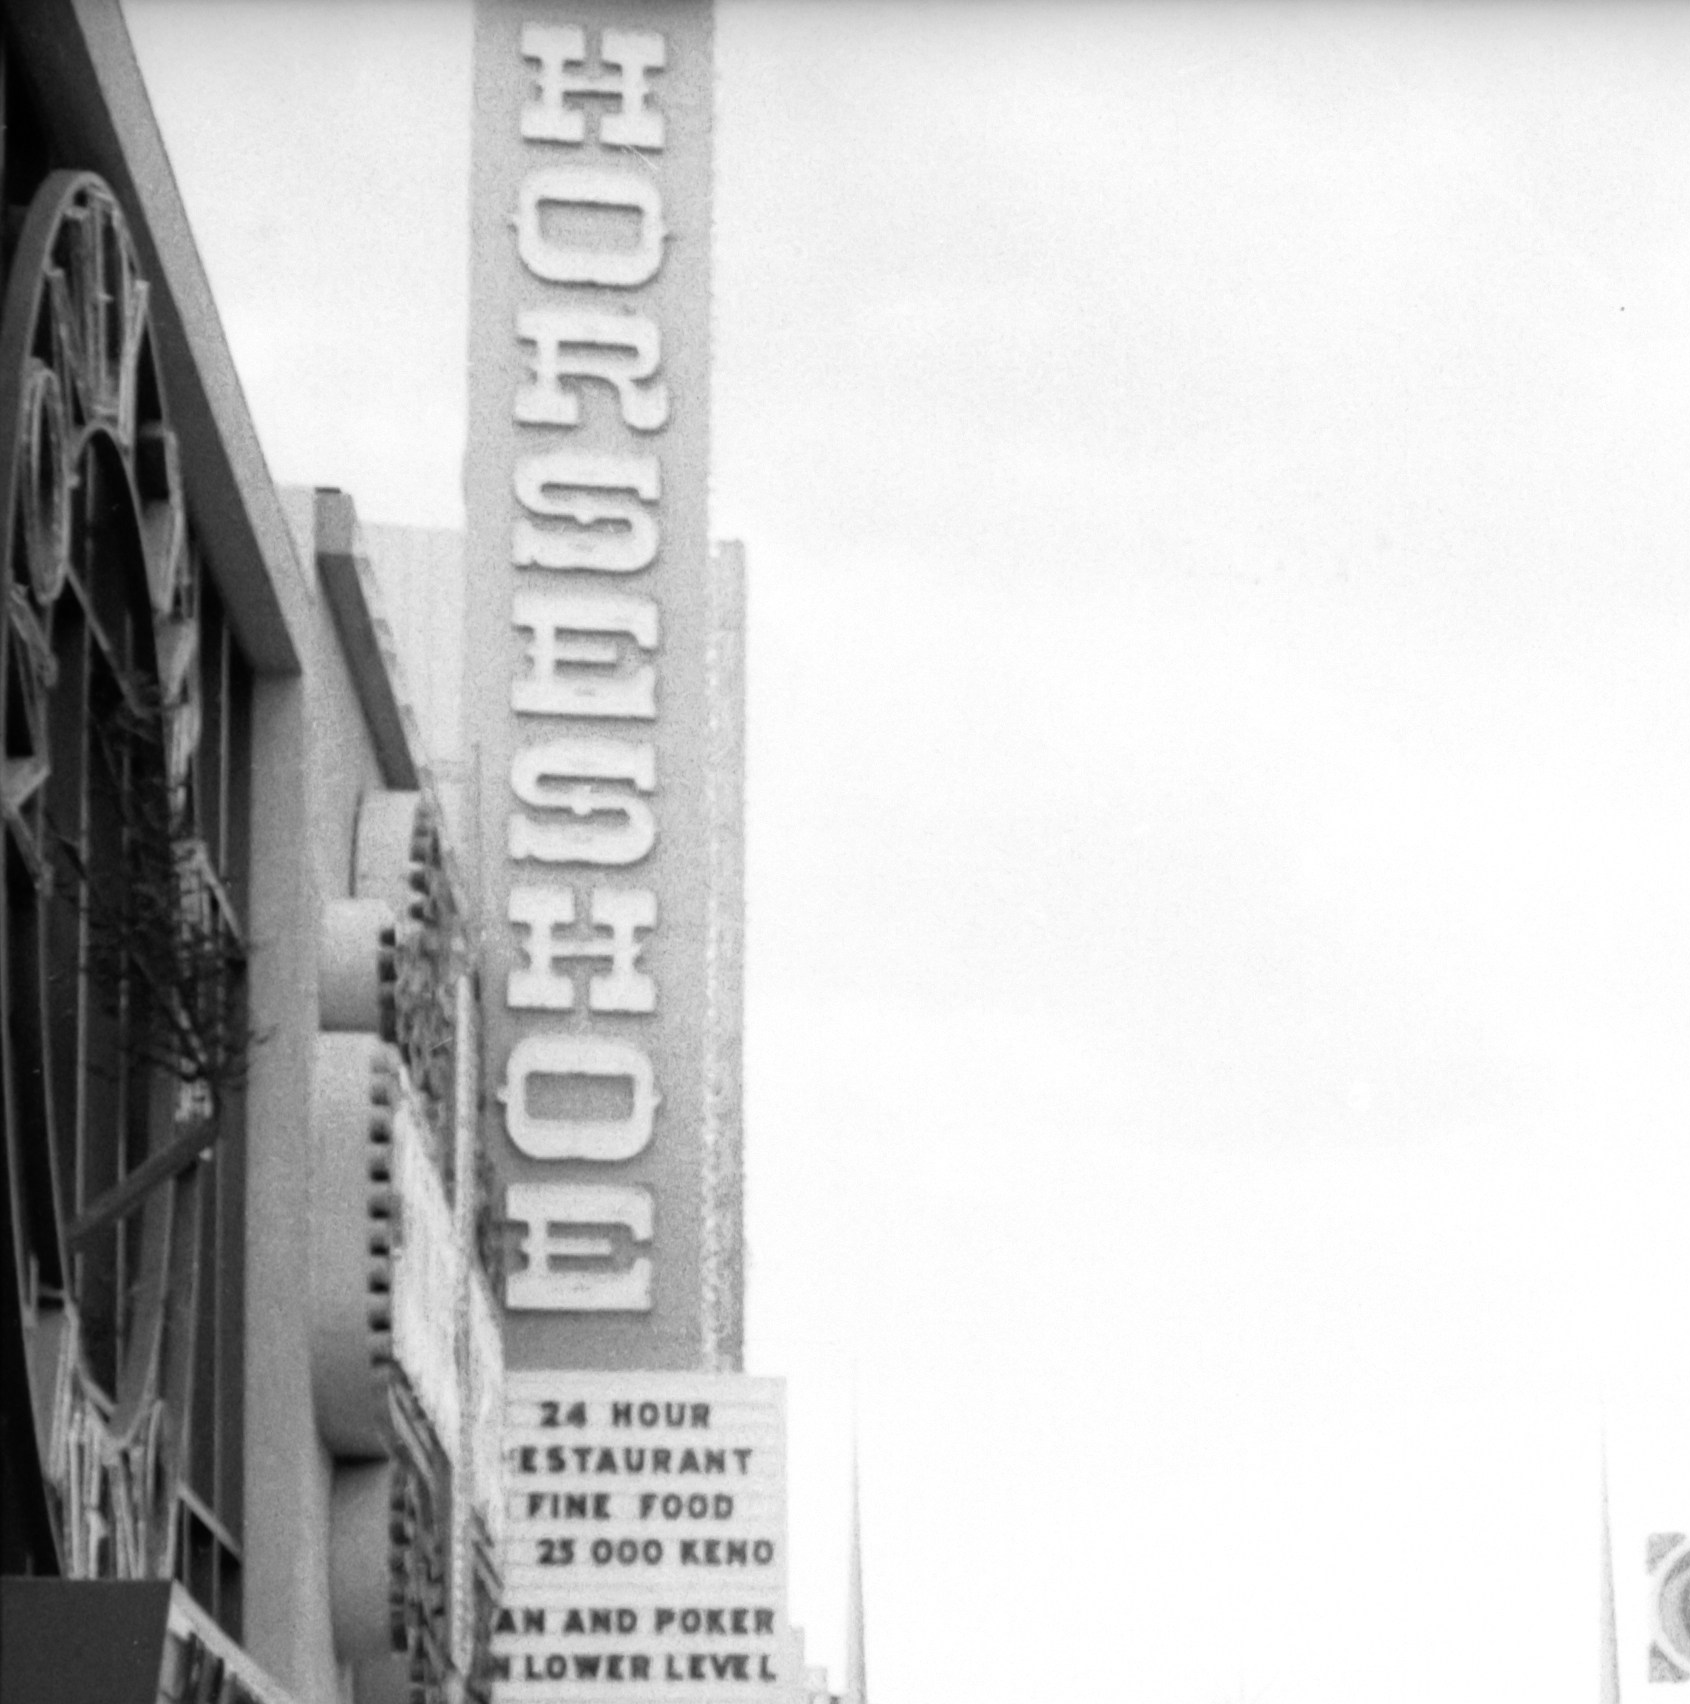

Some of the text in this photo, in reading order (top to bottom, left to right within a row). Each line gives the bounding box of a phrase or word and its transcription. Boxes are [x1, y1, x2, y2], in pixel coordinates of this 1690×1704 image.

[499, 20, 668, 1313] HORSESHOE
[540, 1401, 710, 1428] 24 HOUR
[519, 1446, 752, 1474] ESTAURANT
[528, 1493, 733, 1520] FINE FOOD
[536, 1538, 774, 1566] 25 000 KENO
[495, 1607, 774, 1635] AN AND POKER
[524, 1654, 651, 1681] LOWER
[667, 1654, 777, 1681] LEVEL
